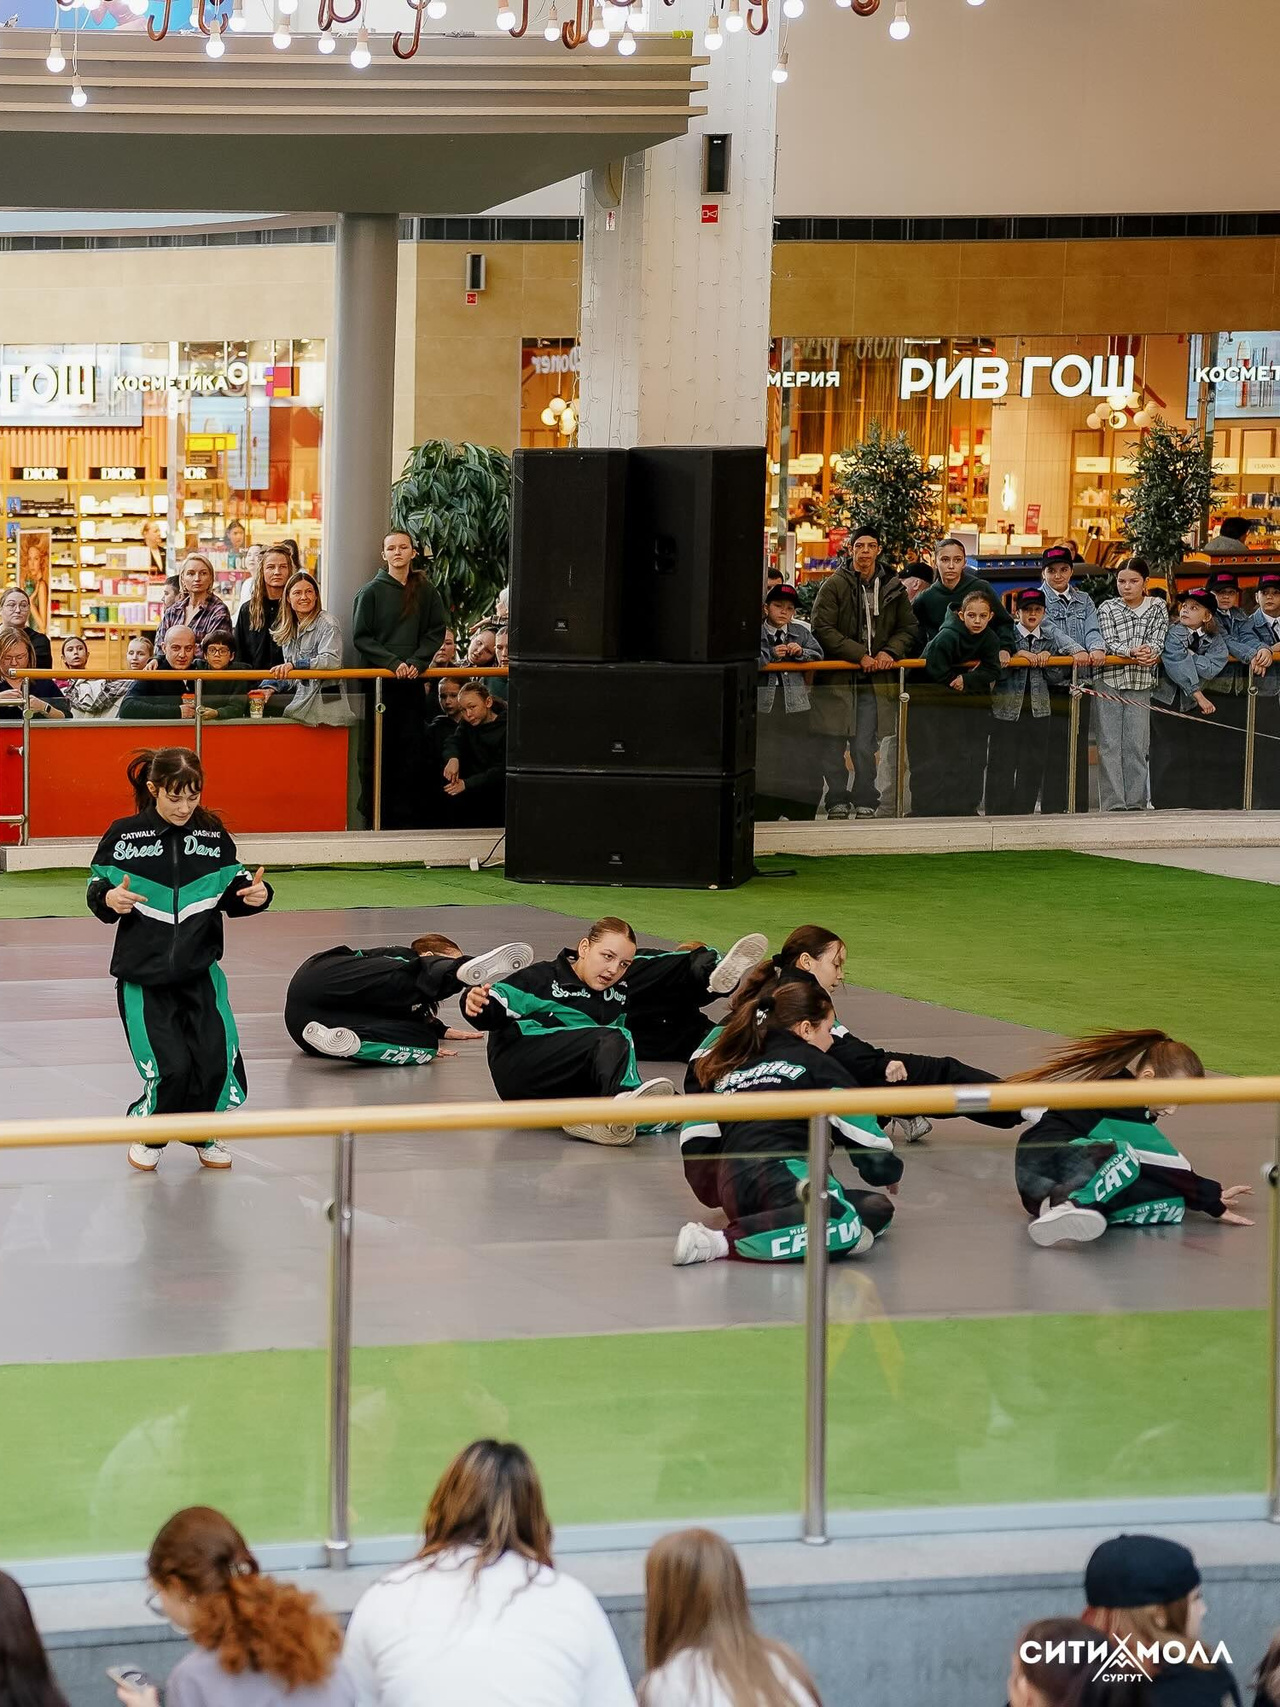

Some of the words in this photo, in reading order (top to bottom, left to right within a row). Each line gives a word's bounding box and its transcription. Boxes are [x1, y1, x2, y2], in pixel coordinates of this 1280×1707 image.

[0, 362, 97, 404] ГОШ
[112, 374, 229, 393] КОСМЕТИКА
[767, 370, 841, 388] МЕРИЯ
[900, 357, 1009, 400] РИВ
[1020, 354, 1135, 398] ГОШ
[23, 467, 59, 481] DIOR
[101, 467, 136, 481] DIOR
[183, 467, 208, 481] IOR
[120, 829, 157, 841] CATWALK
[113, 839, 164, 861] Street
